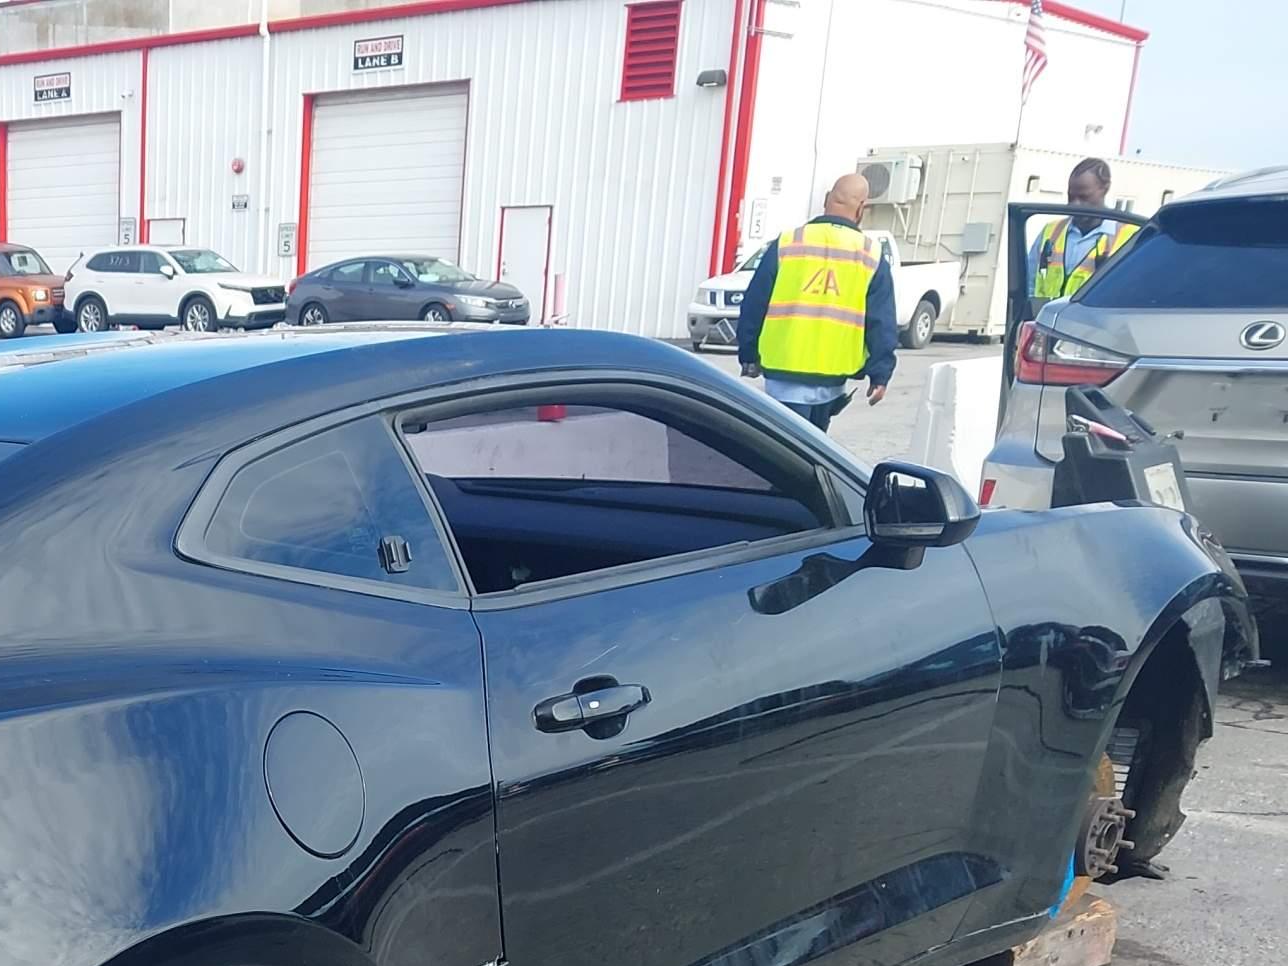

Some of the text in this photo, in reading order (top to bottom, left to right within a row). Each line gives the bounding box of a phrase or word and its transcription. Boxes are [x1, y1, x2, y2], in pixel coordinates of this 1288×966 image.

[371, 41, 382, 53] AND
[384, 39, 401, 52] DRIVE
[358, 54, 399, 68] LANE B
[37, 89, 68, 100] LANE A
[123, 233, 130, 245] 5
[283, 240, 291, 252] 5
